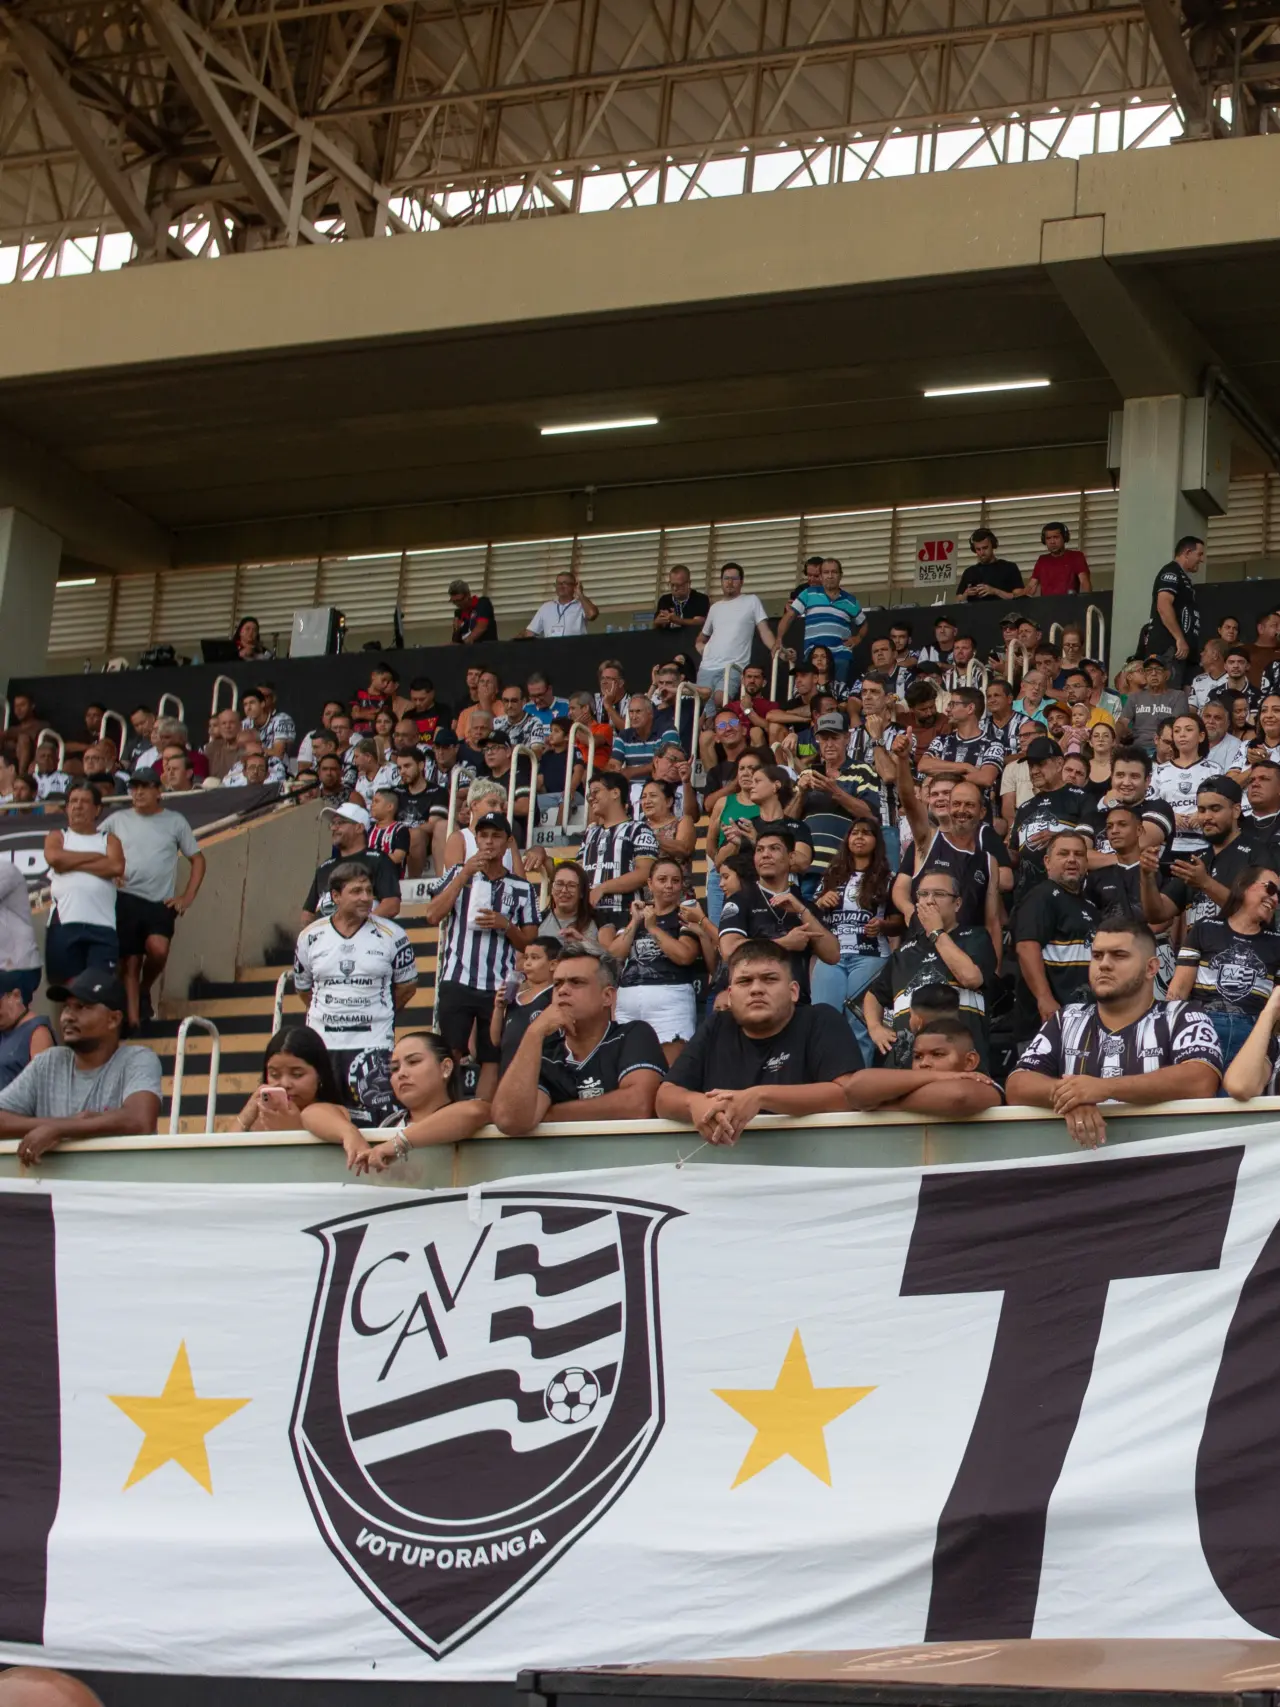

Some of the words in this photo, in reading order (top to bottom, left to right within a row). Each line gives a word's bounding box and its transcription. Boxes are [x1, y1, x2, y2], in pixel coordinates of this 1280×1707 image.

[919, 564, 952, 573] NEWS
[1151, 703, 1172, 715] John
[536, 831, 555, 844] 88
[322, 1013, 373, 1023] PACAEMBU
[1001, 1049, 1012, 1066] 7
[464, 1070, 476, 1088] 8
[350, 1222, 494, 1382] CAV
[355, 1527, 547, 1570] VOTUPORANGA
